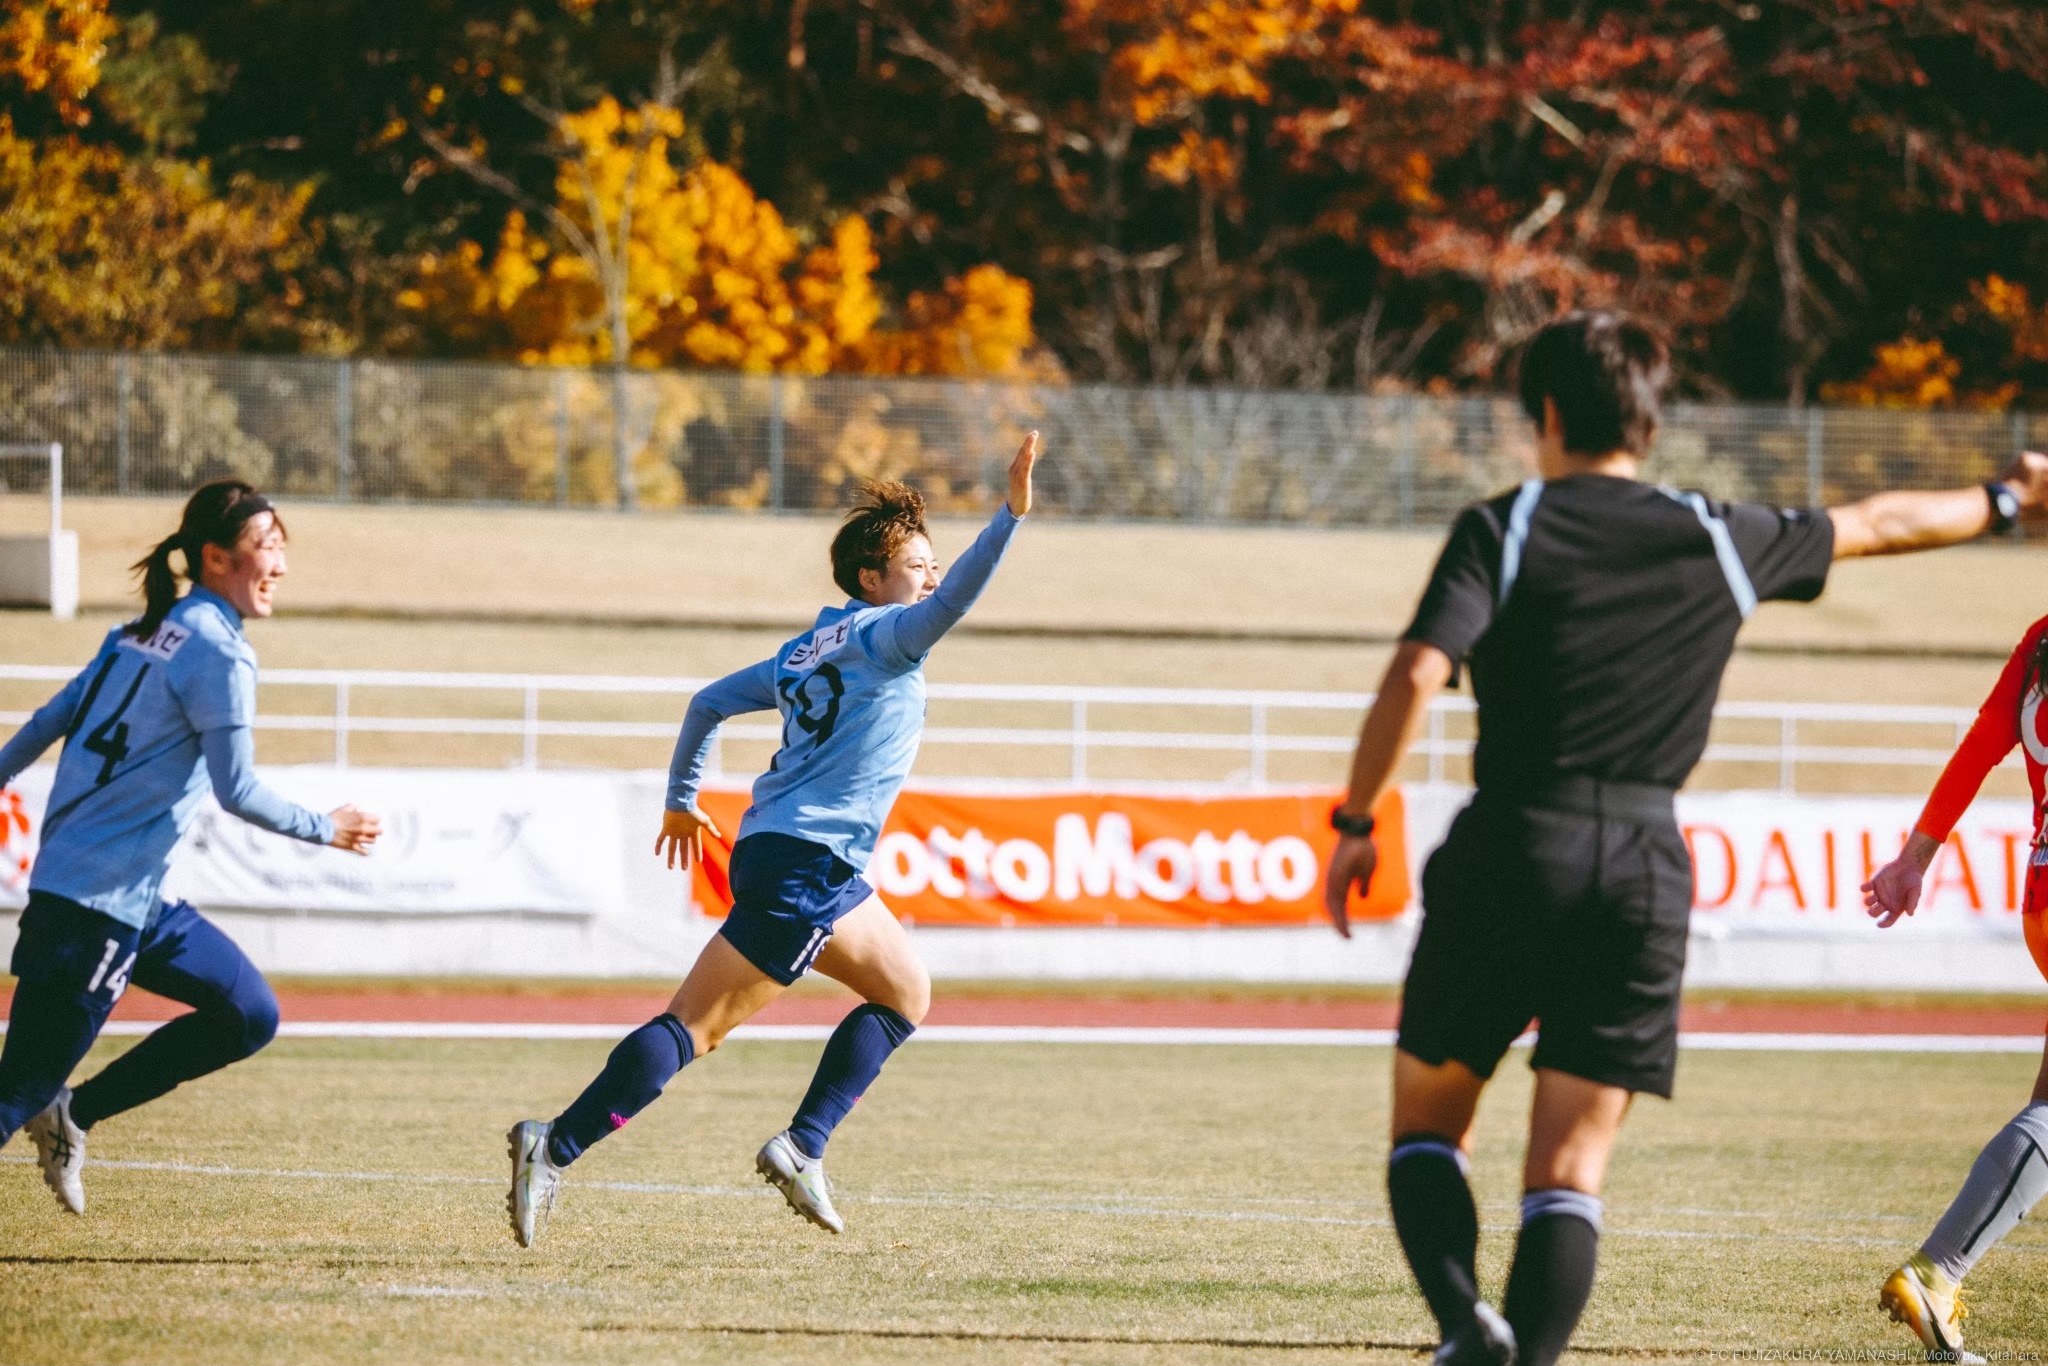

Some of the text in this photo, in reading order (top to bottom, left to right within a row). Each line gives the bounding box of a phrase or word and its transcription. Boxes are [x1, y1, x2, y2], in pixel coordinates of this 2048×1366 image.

[66, 652, 152, 785] 14
[769, 661, 845, 771] 19
[866, 811, 1319, 905] ottoMotto
[88, 937, 137, 1003] 14
